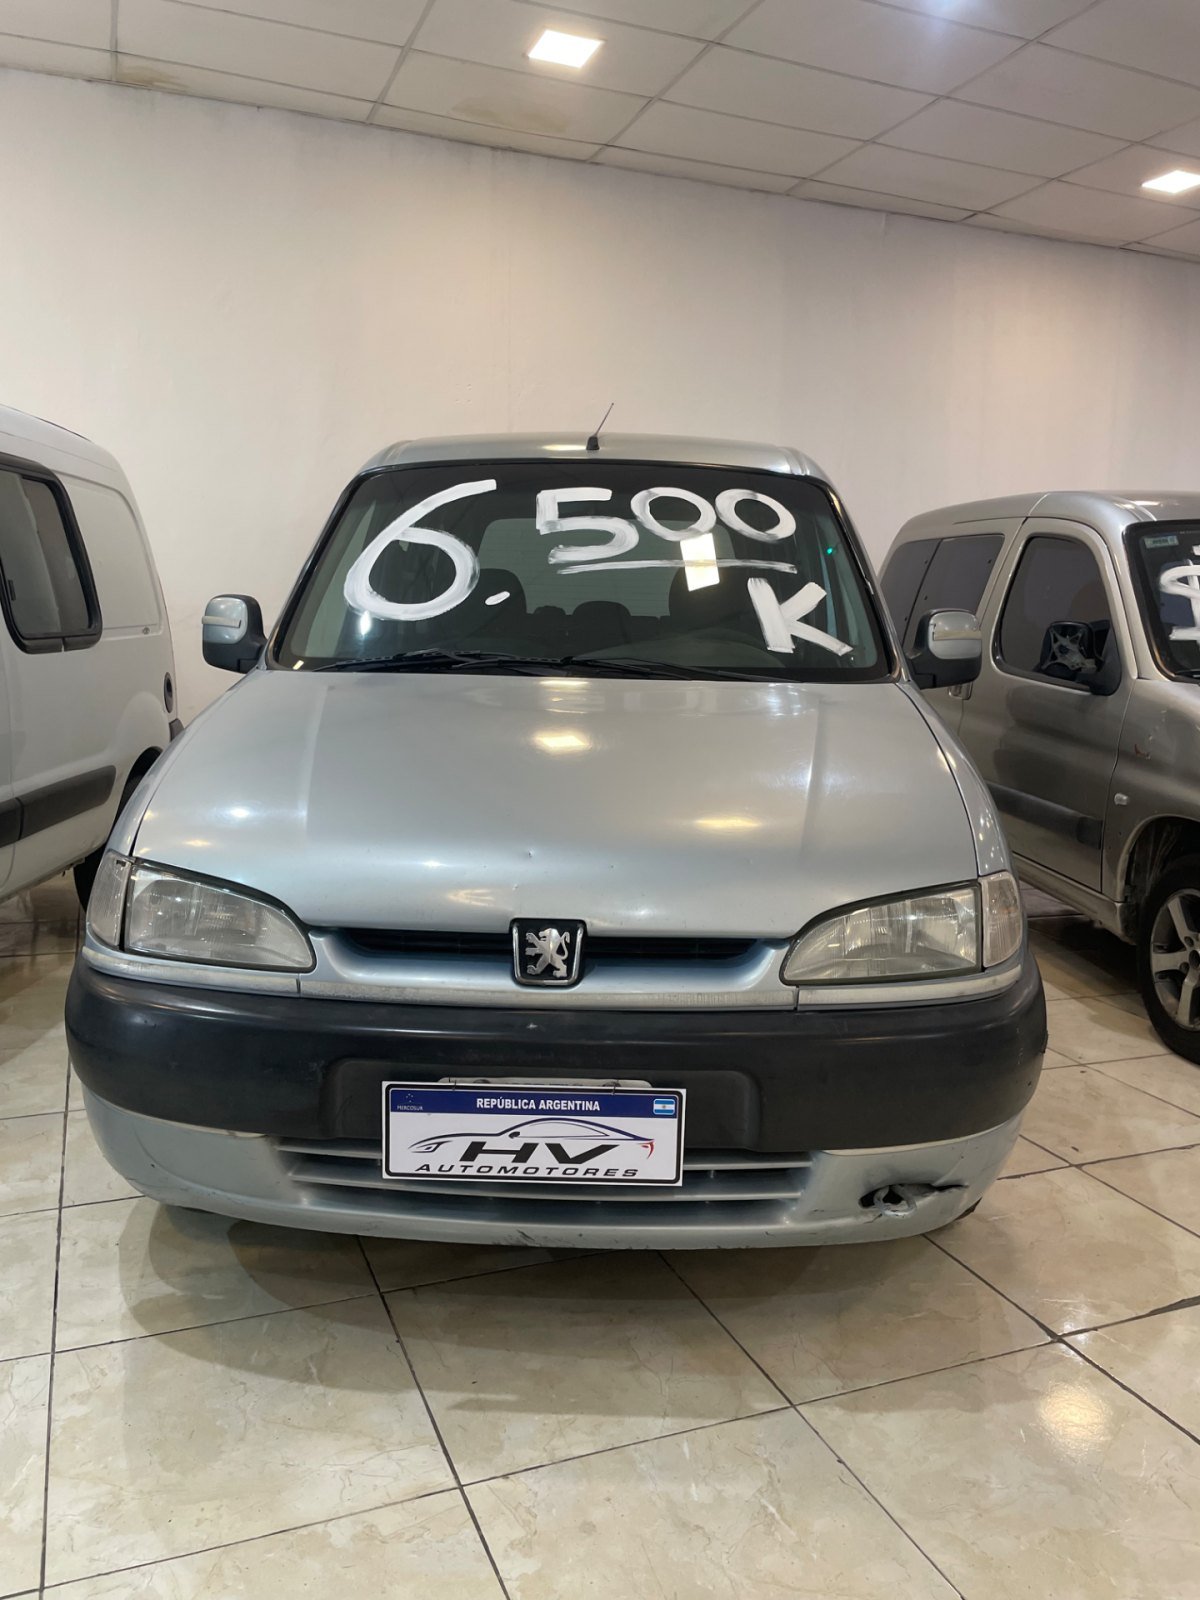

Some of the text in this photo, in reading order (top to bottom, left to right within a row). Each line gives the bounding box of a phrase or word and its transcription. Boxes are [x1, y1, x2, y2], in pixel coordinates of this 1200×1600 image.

[747, 578, 853, 656] K
[476, 1097, 600, 1111] REPÚBLICA ARGENTINA
[460, 1141, 619, 1164] HV
[416, 1164, 638, 1177] AUTOMOTORES
